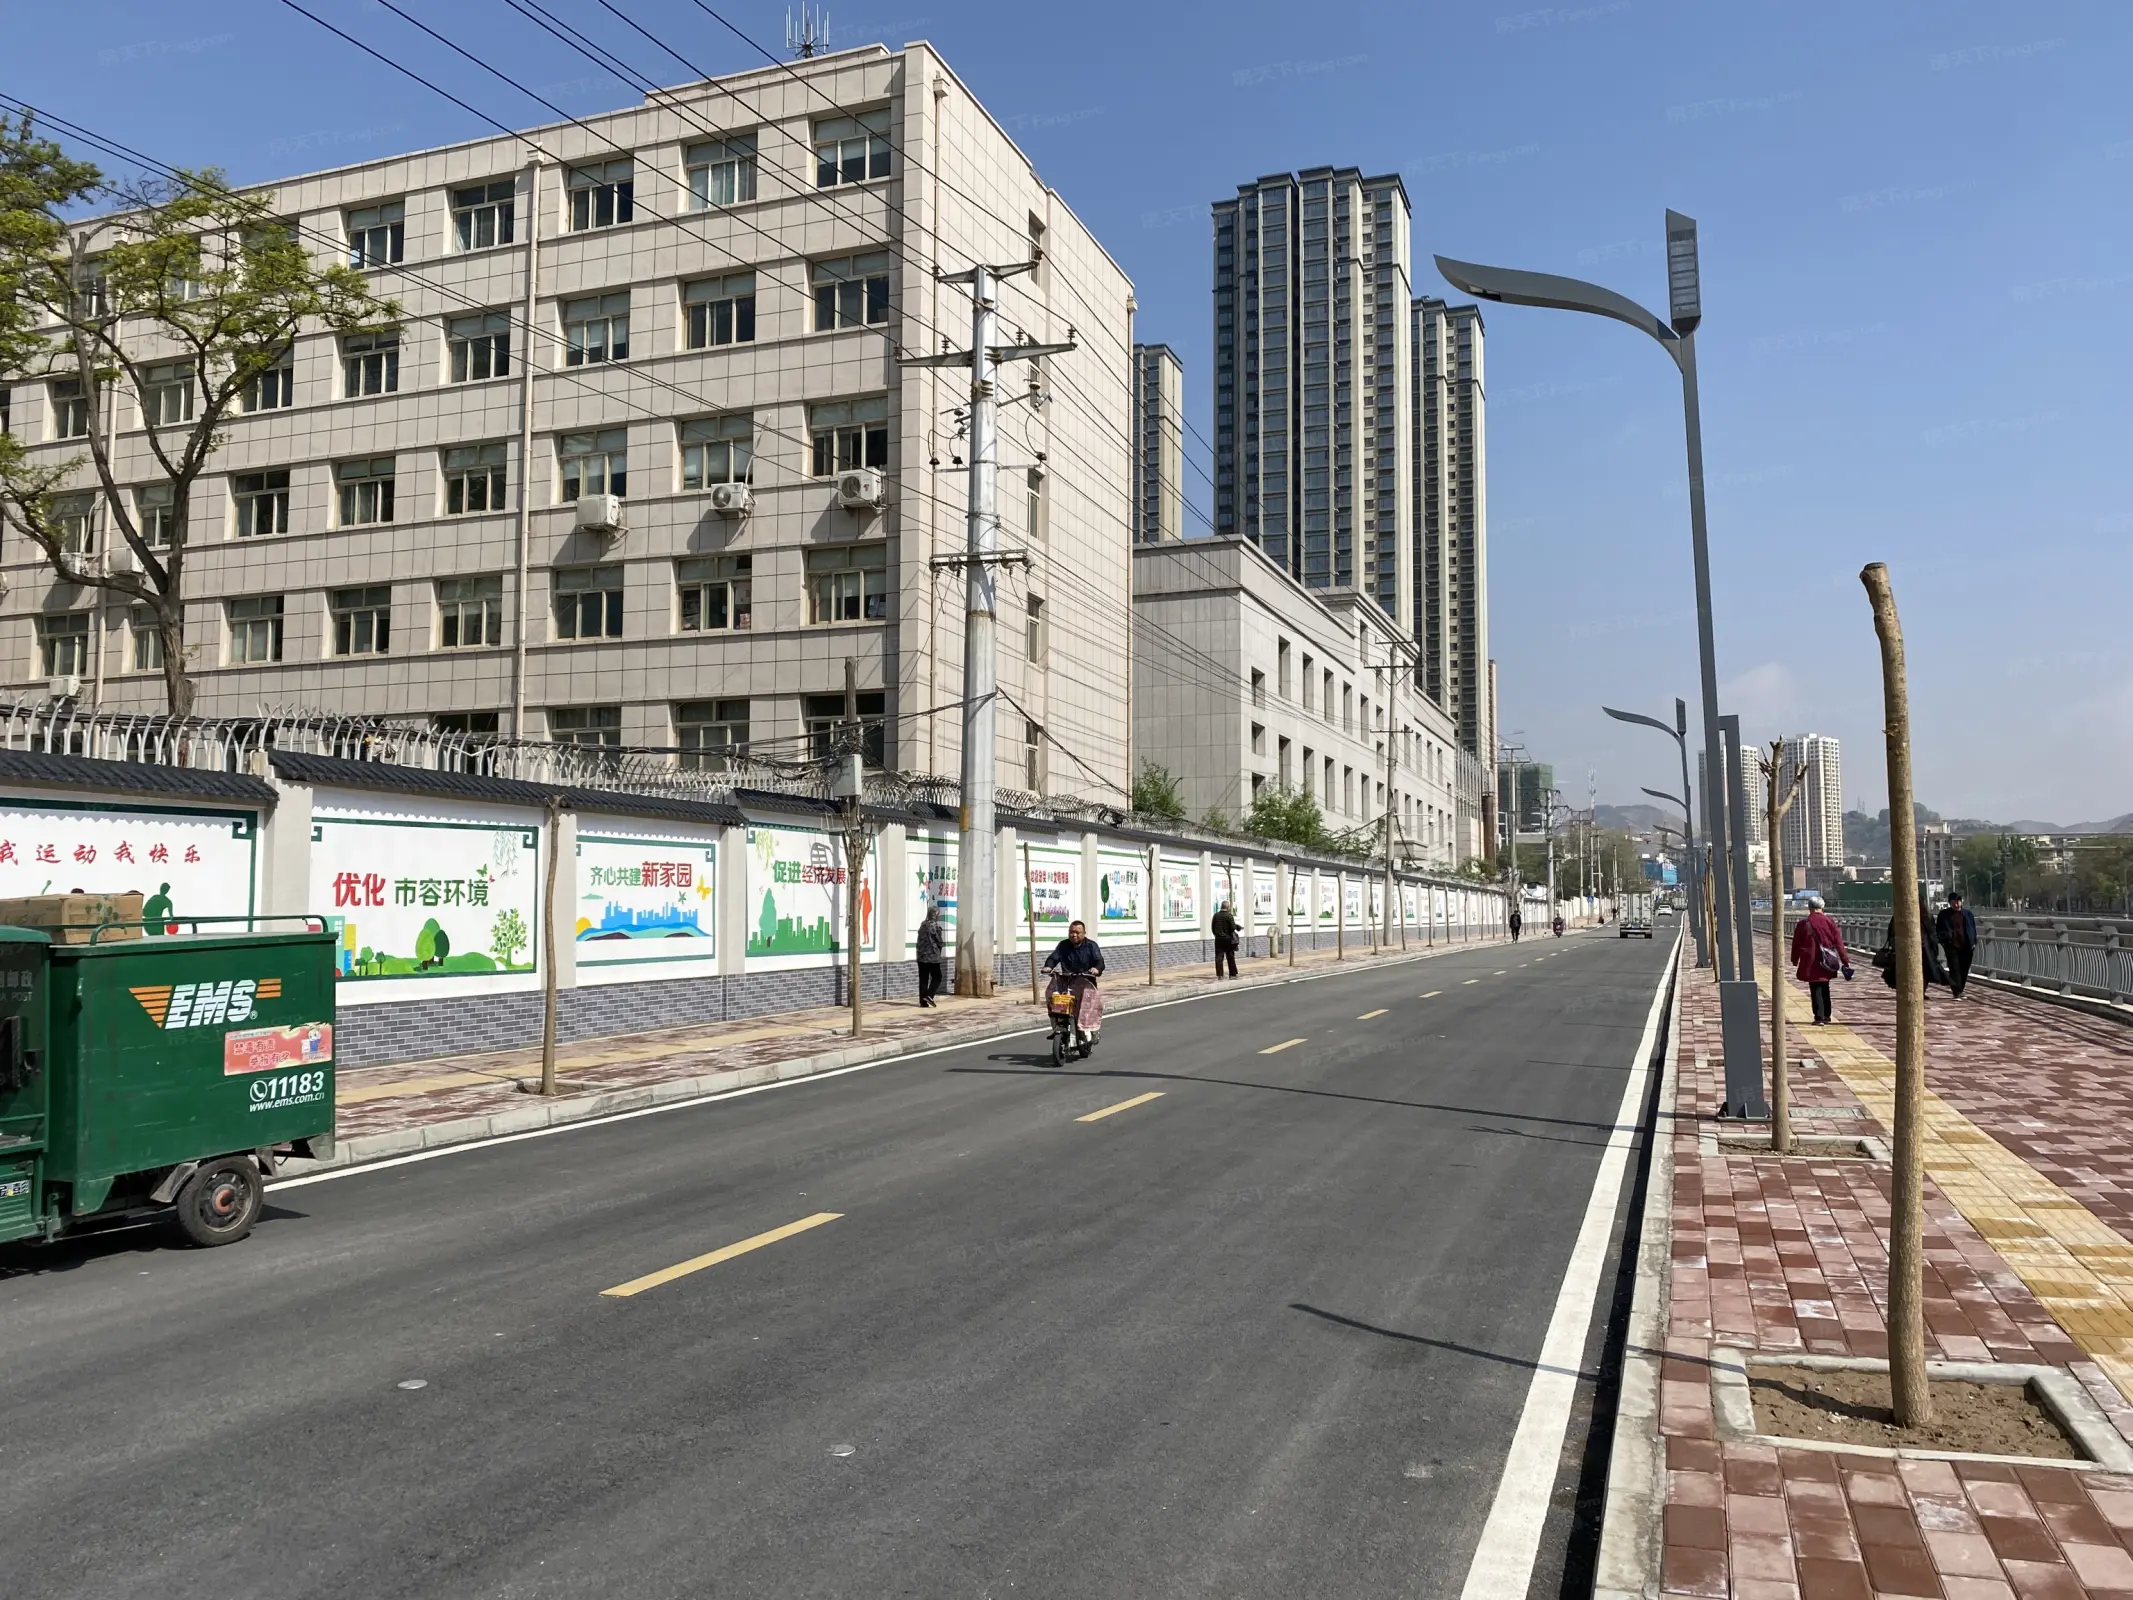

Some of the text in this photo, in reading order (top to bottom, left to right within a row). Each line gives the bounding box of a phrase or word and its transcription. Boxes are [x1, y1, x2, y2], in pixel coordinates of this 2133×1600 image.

[0, 839, 201, 866] 我运动我快乐
[590, 861, 692, 888] 齐心共建新家园
[772, 860, 846, 884] 促进经济发展
[332, 872, 489, 907] 优化 市容环境
[165, 979, 256, 1029] EMS
[268, 1071, 324, 1099] 11183
[249, 1091, 325, 1113] www.ems.com.cn
